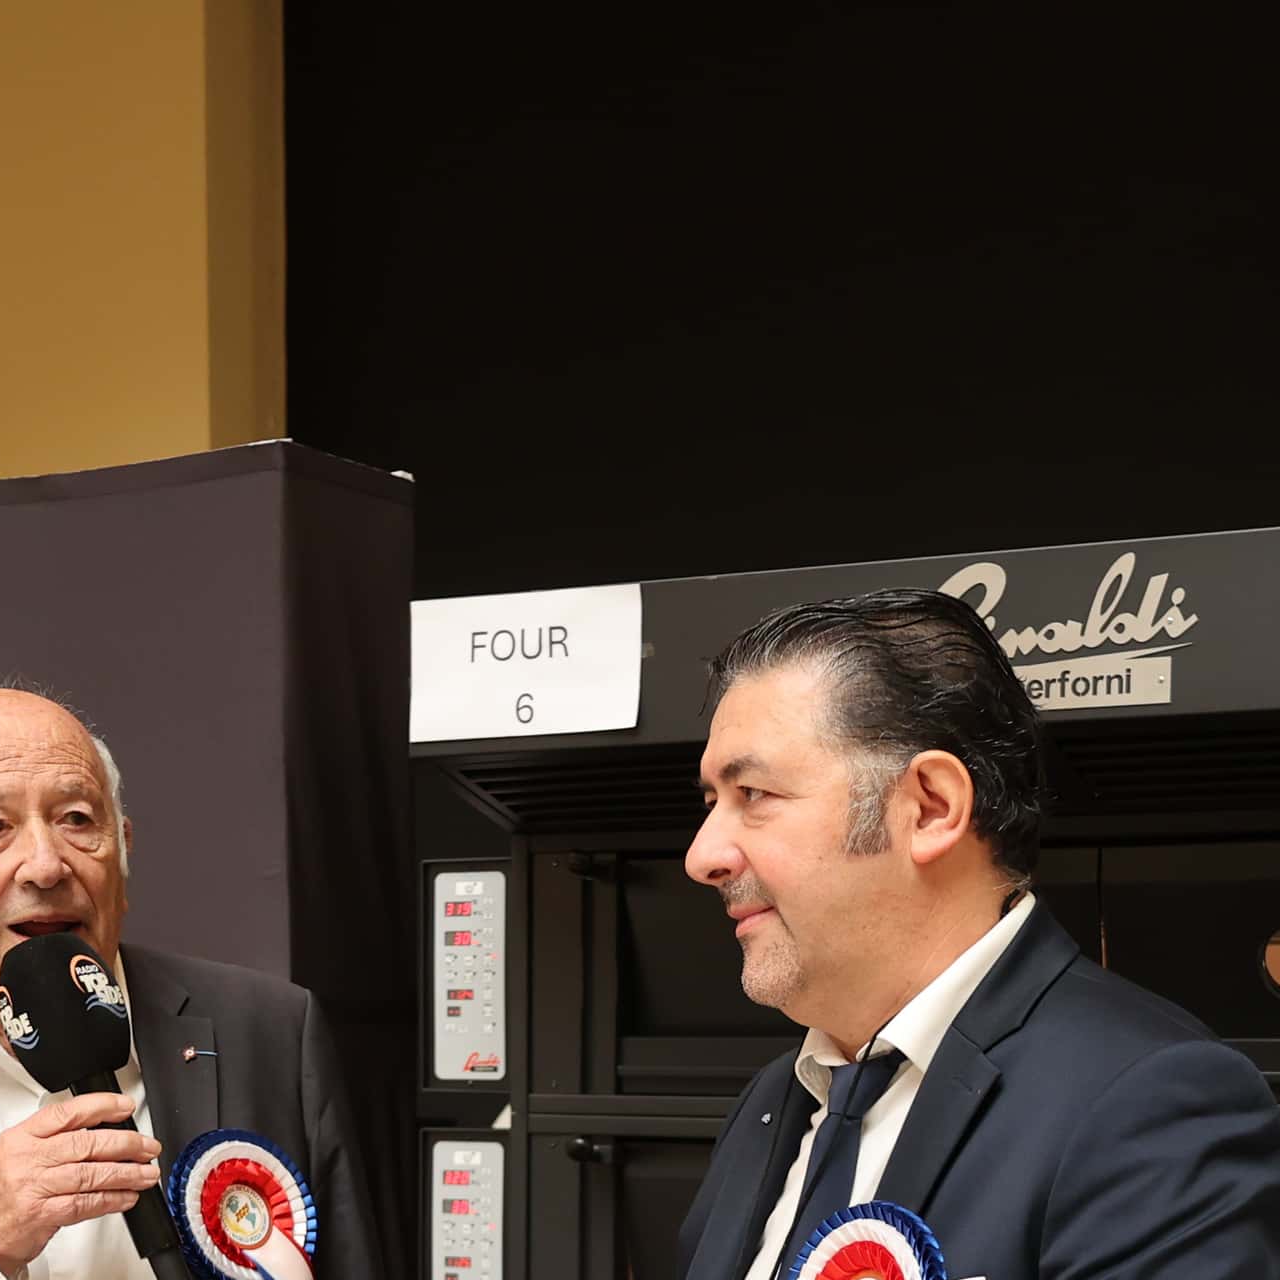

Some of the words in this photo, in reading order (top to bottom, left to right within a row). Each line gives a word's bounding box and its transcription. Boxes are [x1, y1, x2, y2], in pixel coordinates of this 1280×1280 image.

[471, 626, 569, 663] FOUR
[1023, 668, 1132, 700] erforni
[516, 692, 534, 725] 6
